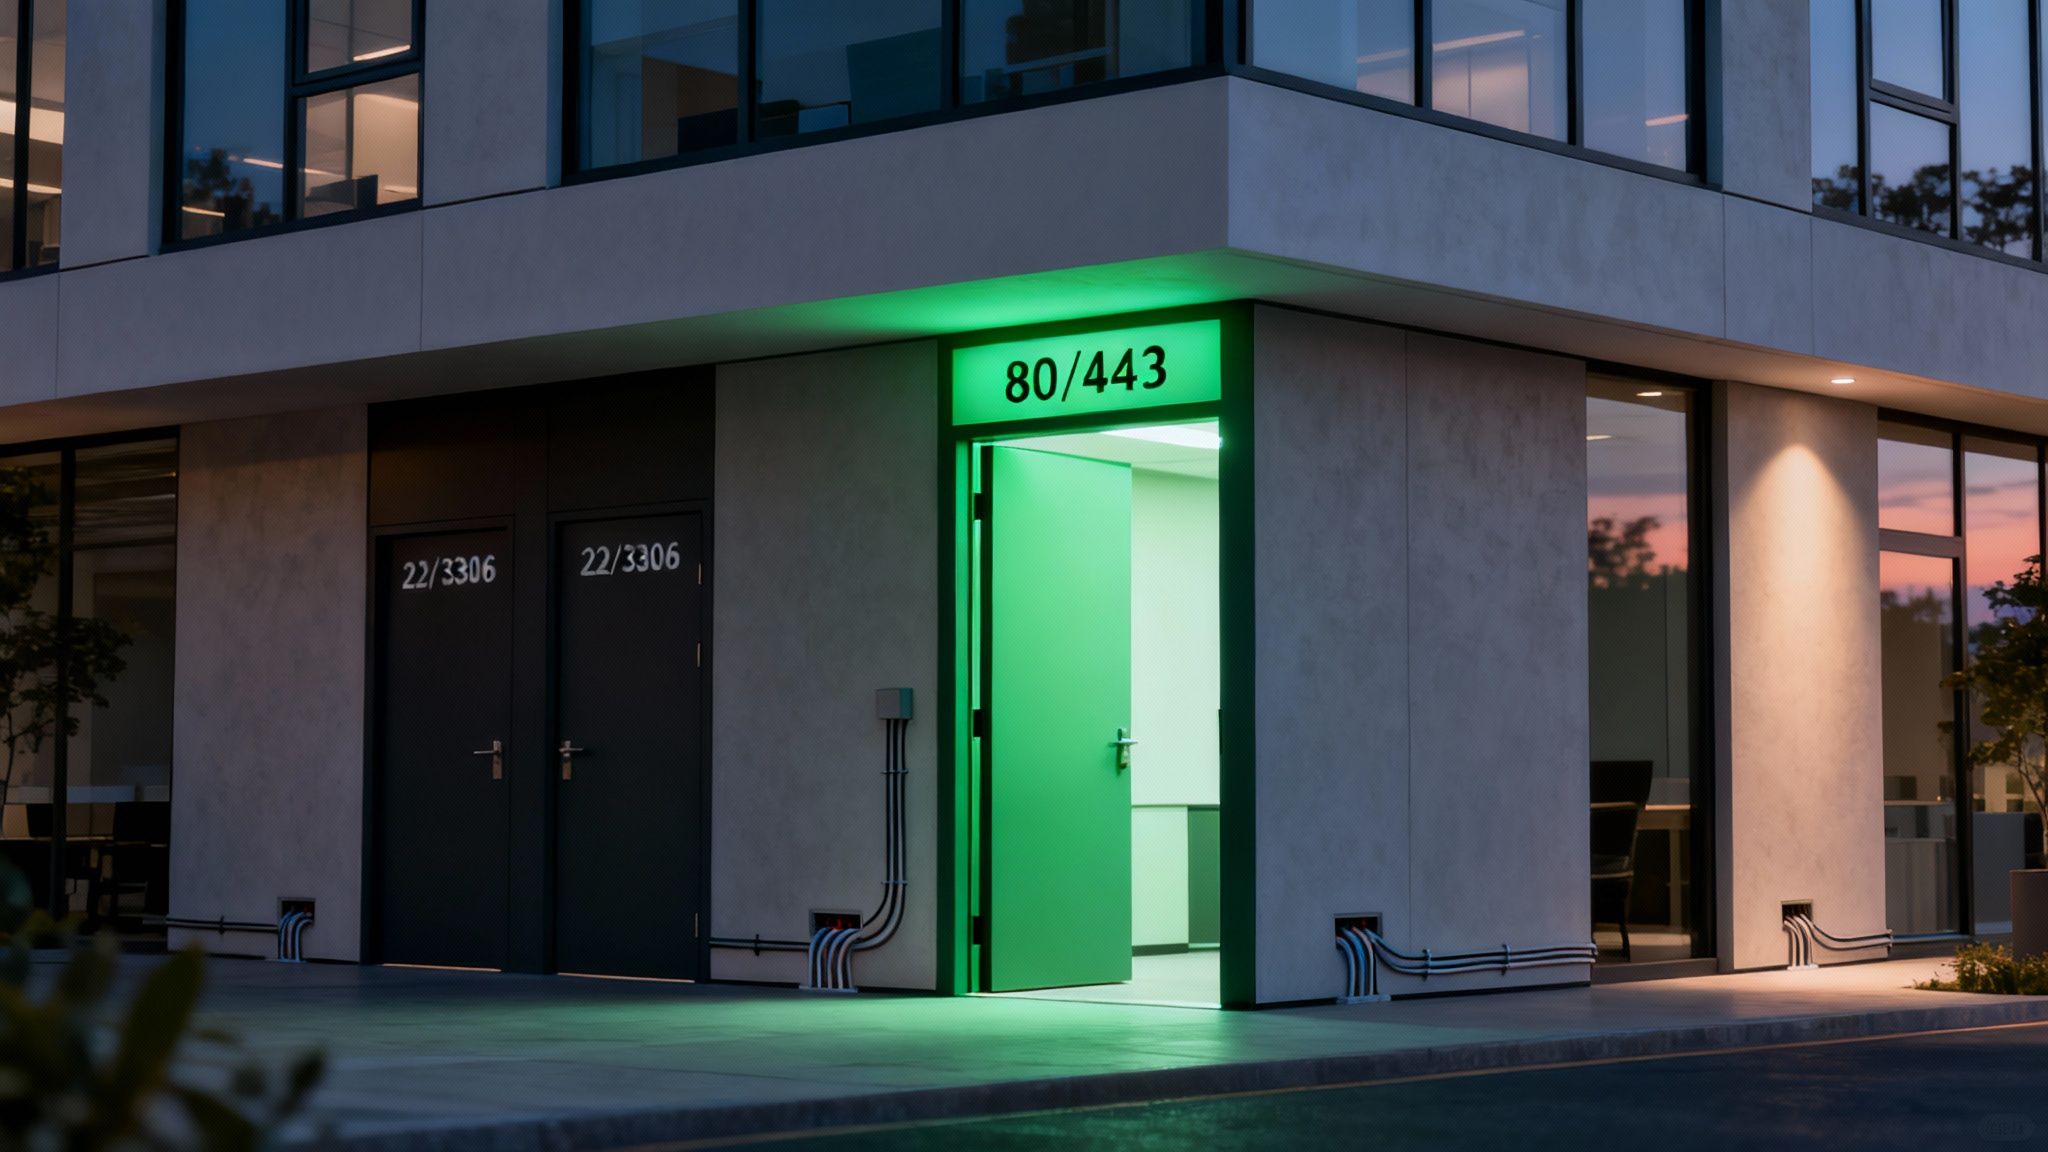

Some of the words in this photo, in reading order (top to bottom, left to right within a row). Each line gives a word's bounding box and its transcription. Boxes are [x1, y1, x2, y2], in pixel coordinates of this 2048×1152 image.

[1005, 345, 1167, 403] 80/443
[402, 554, 497, 589] 22/3306
[580, 541, 681, 576] 22/3306
